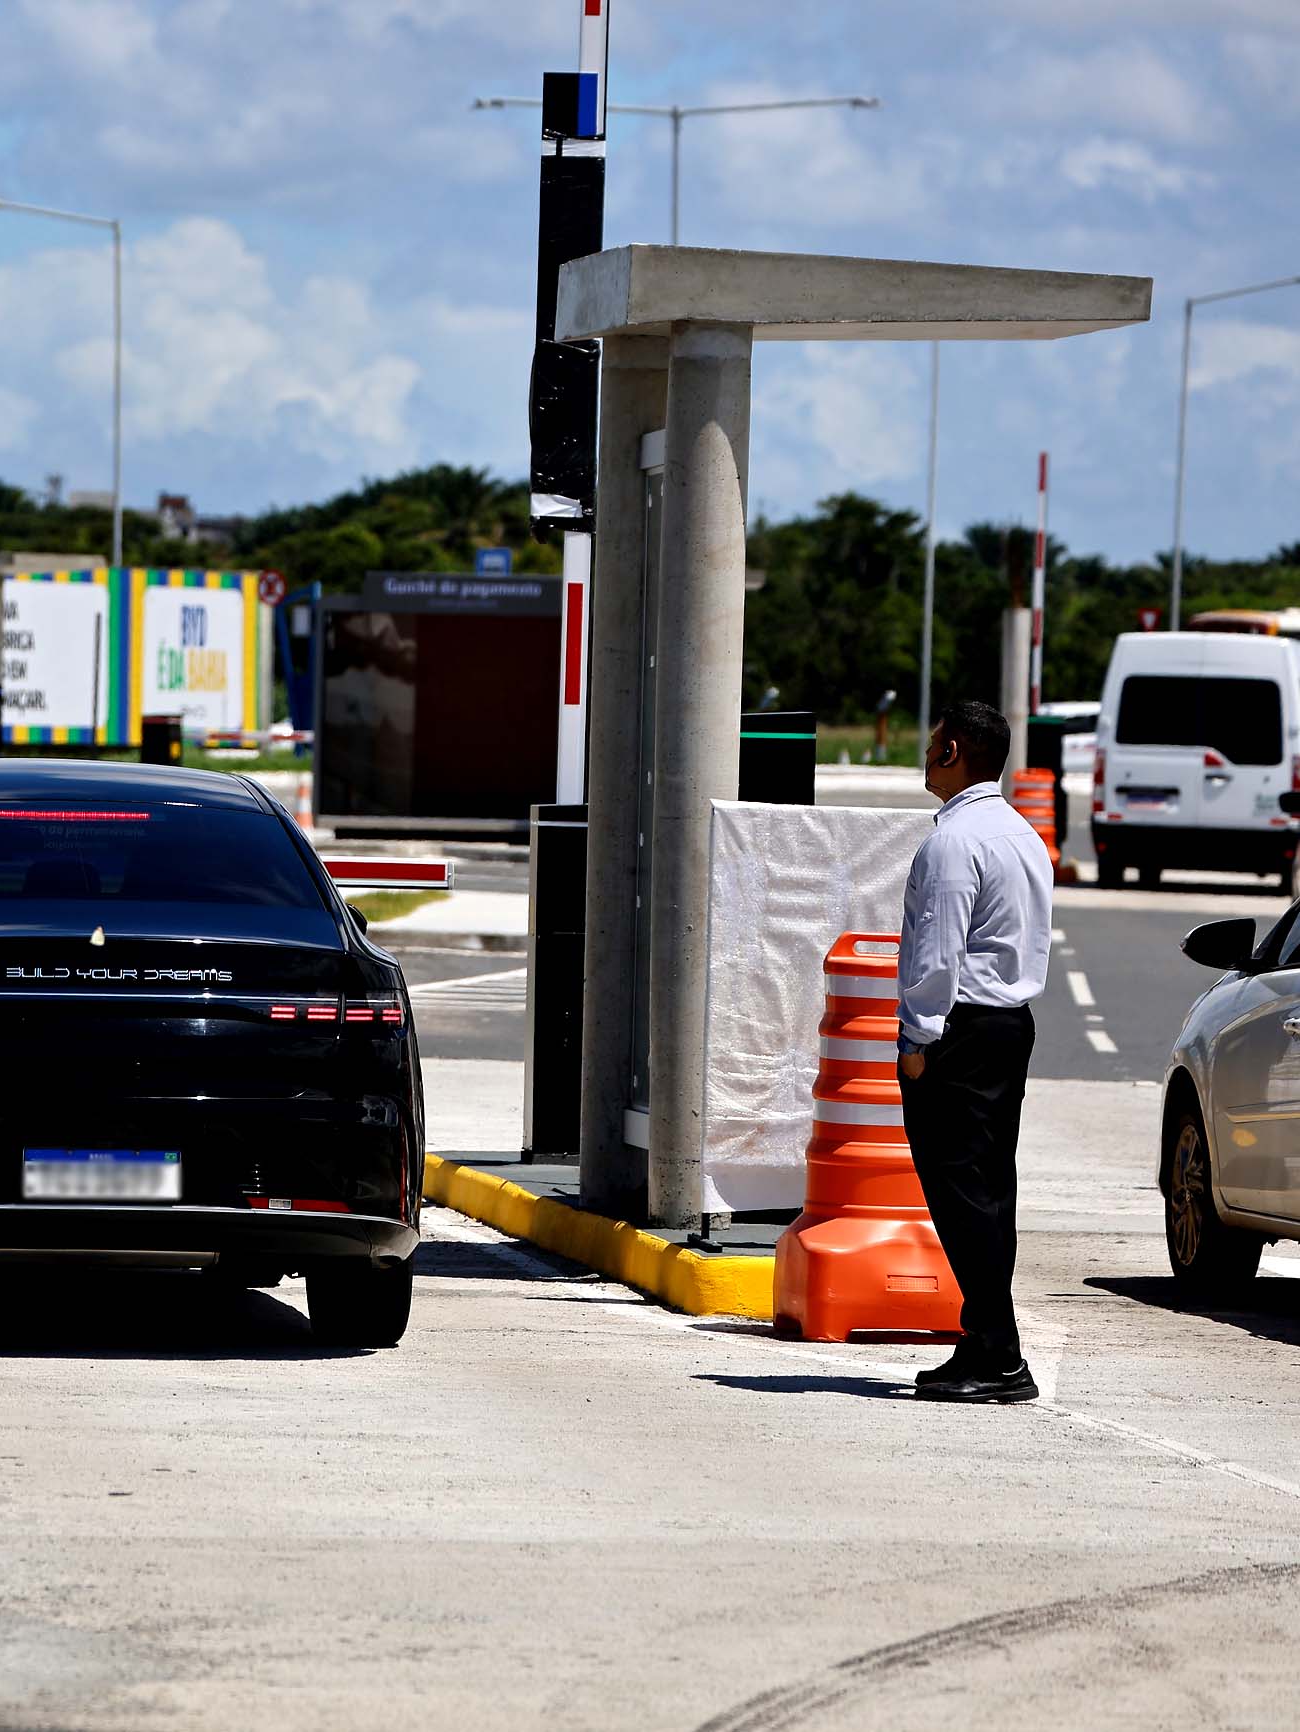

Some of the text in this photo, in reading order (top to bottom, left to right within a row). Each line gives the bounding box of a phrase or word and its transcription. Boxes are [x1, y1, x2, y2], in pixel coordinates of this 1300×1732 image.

[181, 605, 206, 647] BYD
[157, 638, 227, 693] É DA BAHIA
[5, 966, 233, 982] BUILD YOUR DREAMS
